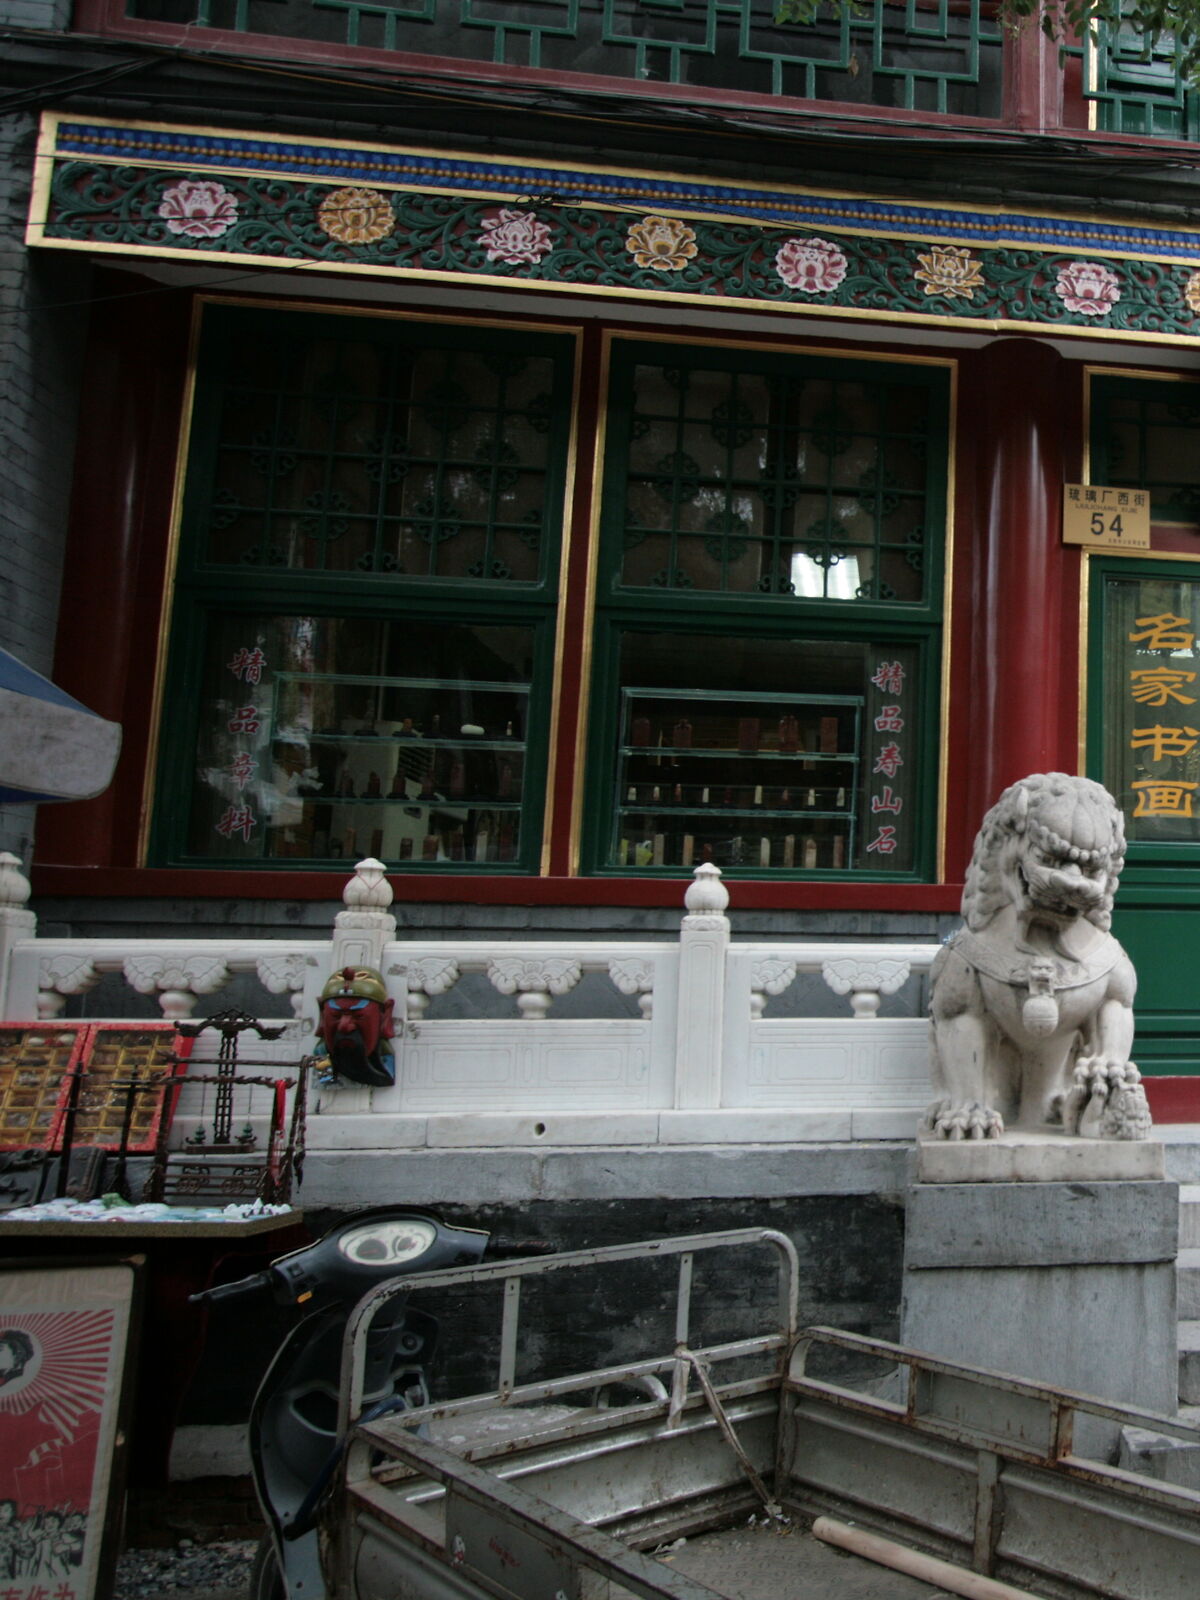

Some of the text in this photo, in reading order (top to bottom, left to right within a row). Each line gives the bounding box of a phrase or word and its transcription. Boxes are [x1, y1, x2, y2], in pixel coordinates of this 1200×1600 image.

[1091, 512, 1124, 537] 54
[215, 648, 267, 843] 精品章料
[867, 661, 906, 854] 精品寿山石
[1129, 612, 1200, 818] 名家书画
